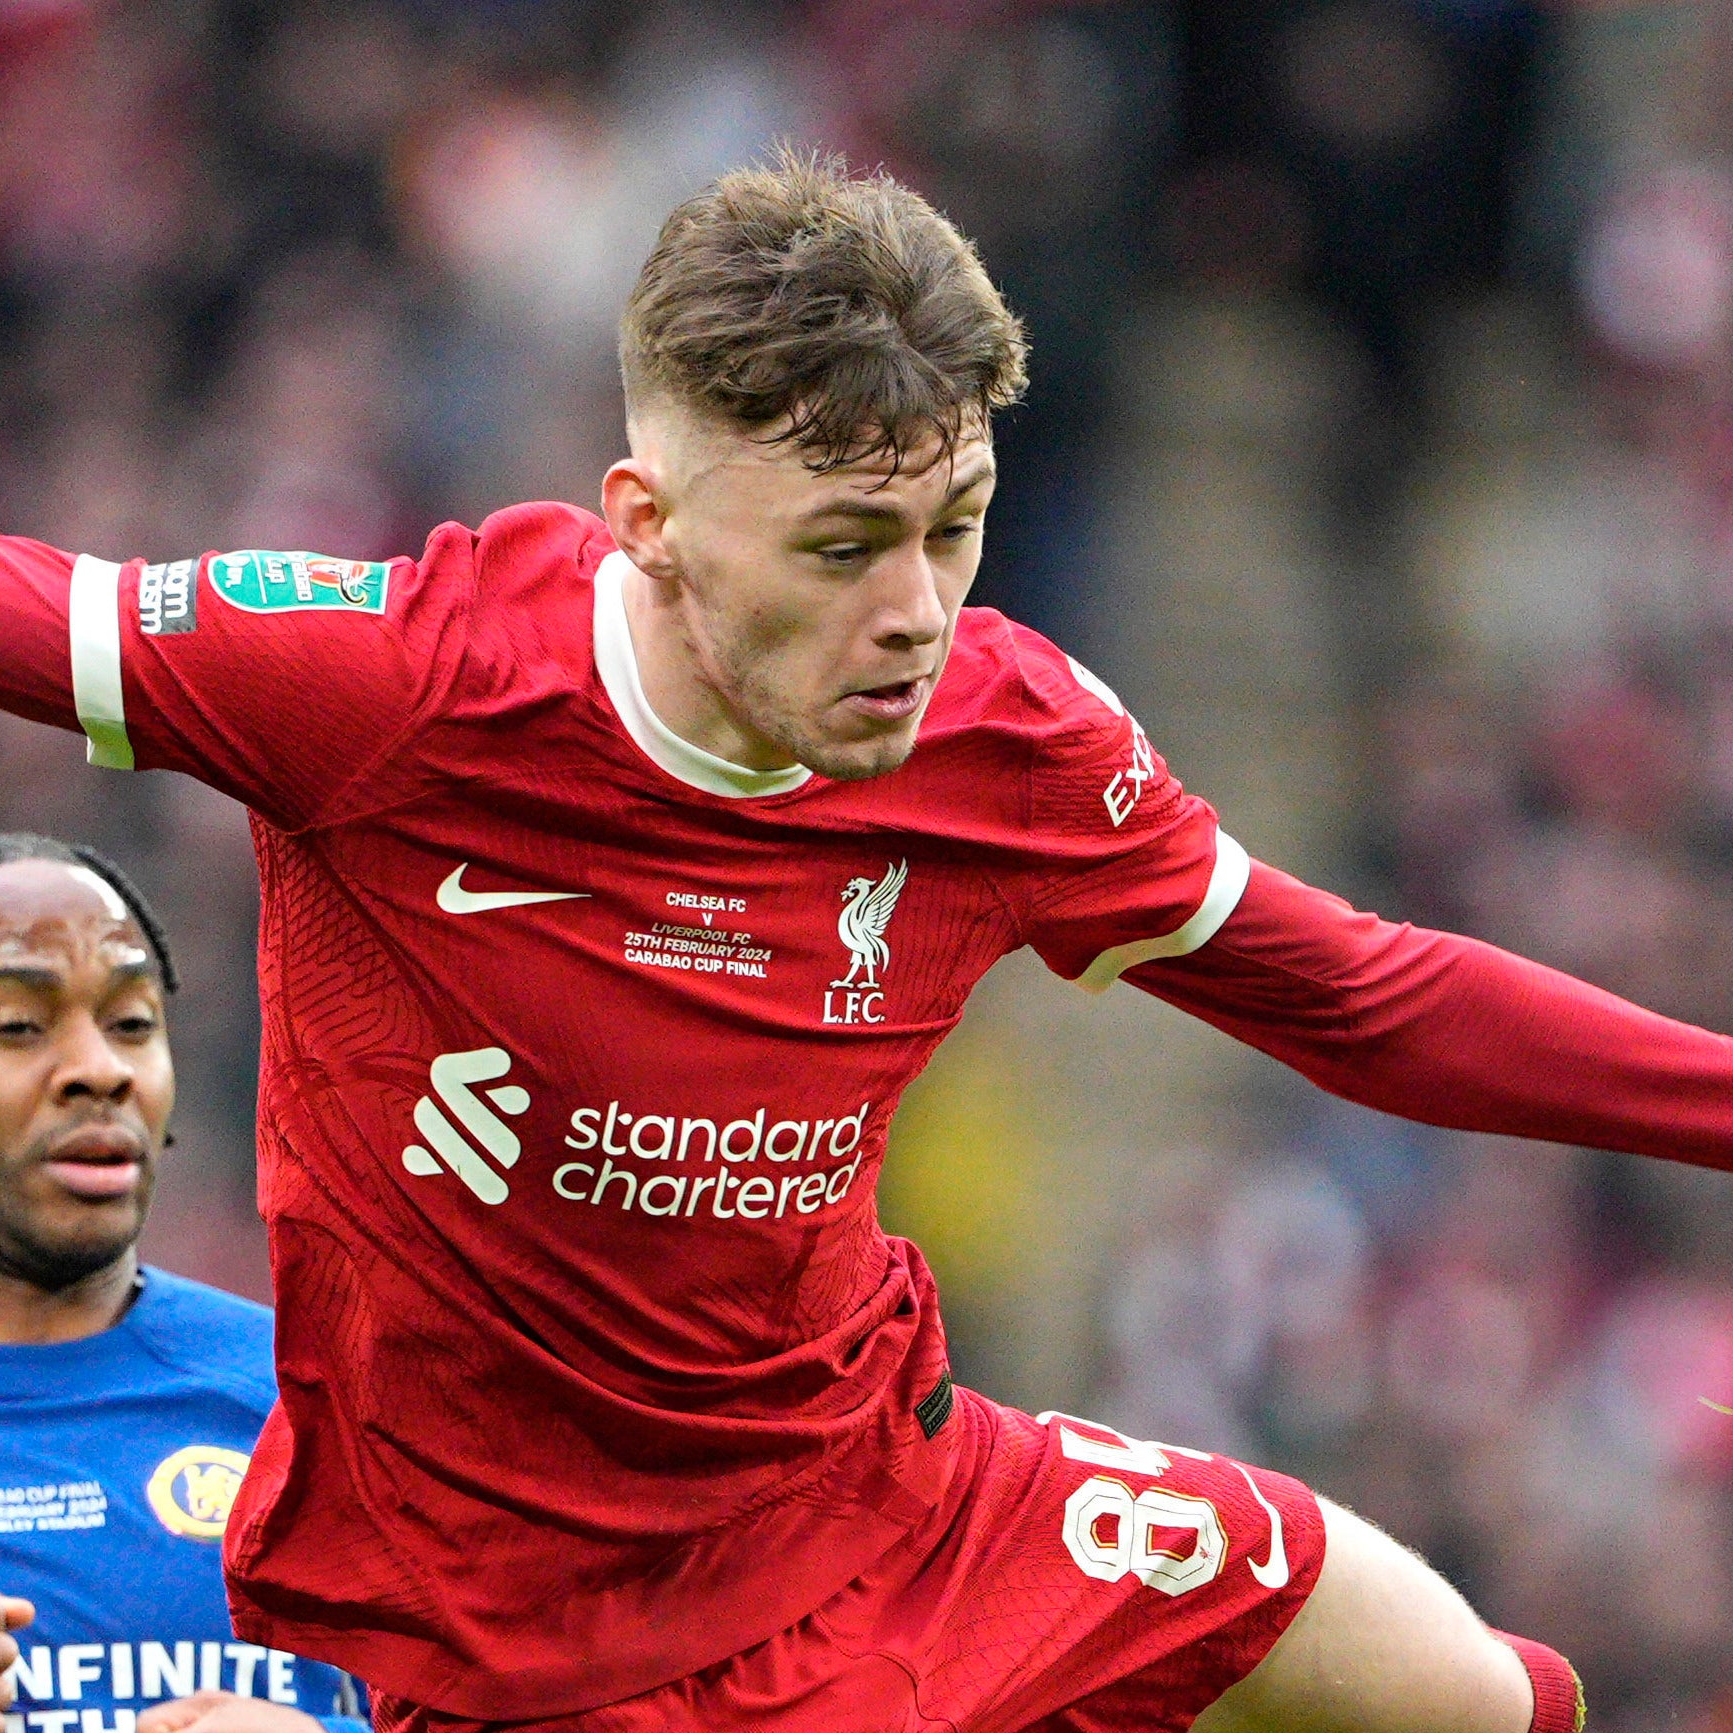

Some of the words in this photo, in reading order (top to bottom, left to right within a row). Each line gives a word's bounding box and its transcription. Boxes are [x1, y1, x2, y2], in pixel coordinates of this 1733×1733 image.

[666, 892, 726, 911] CHELSEA
[728, 899, 747, 912] FC
[624, 932, 662, 949] 25TH
[664, 938, 736, 958] FEBRUARY
[737, 948, 772, 962] 2024
[651, 922, 729, 943] LIVERPOOL
[732, 932, 751, 945] FC
[624, 949, 692, 970] CARABAO
[694, 957, 723, 973] CUP
[726, 961, 767, 978] FINAL
[563, 1100, 870, 1164] standard
[551, 1148, 864, 1220] chartered
[9, 1640, 298, 1703] NFINITE
